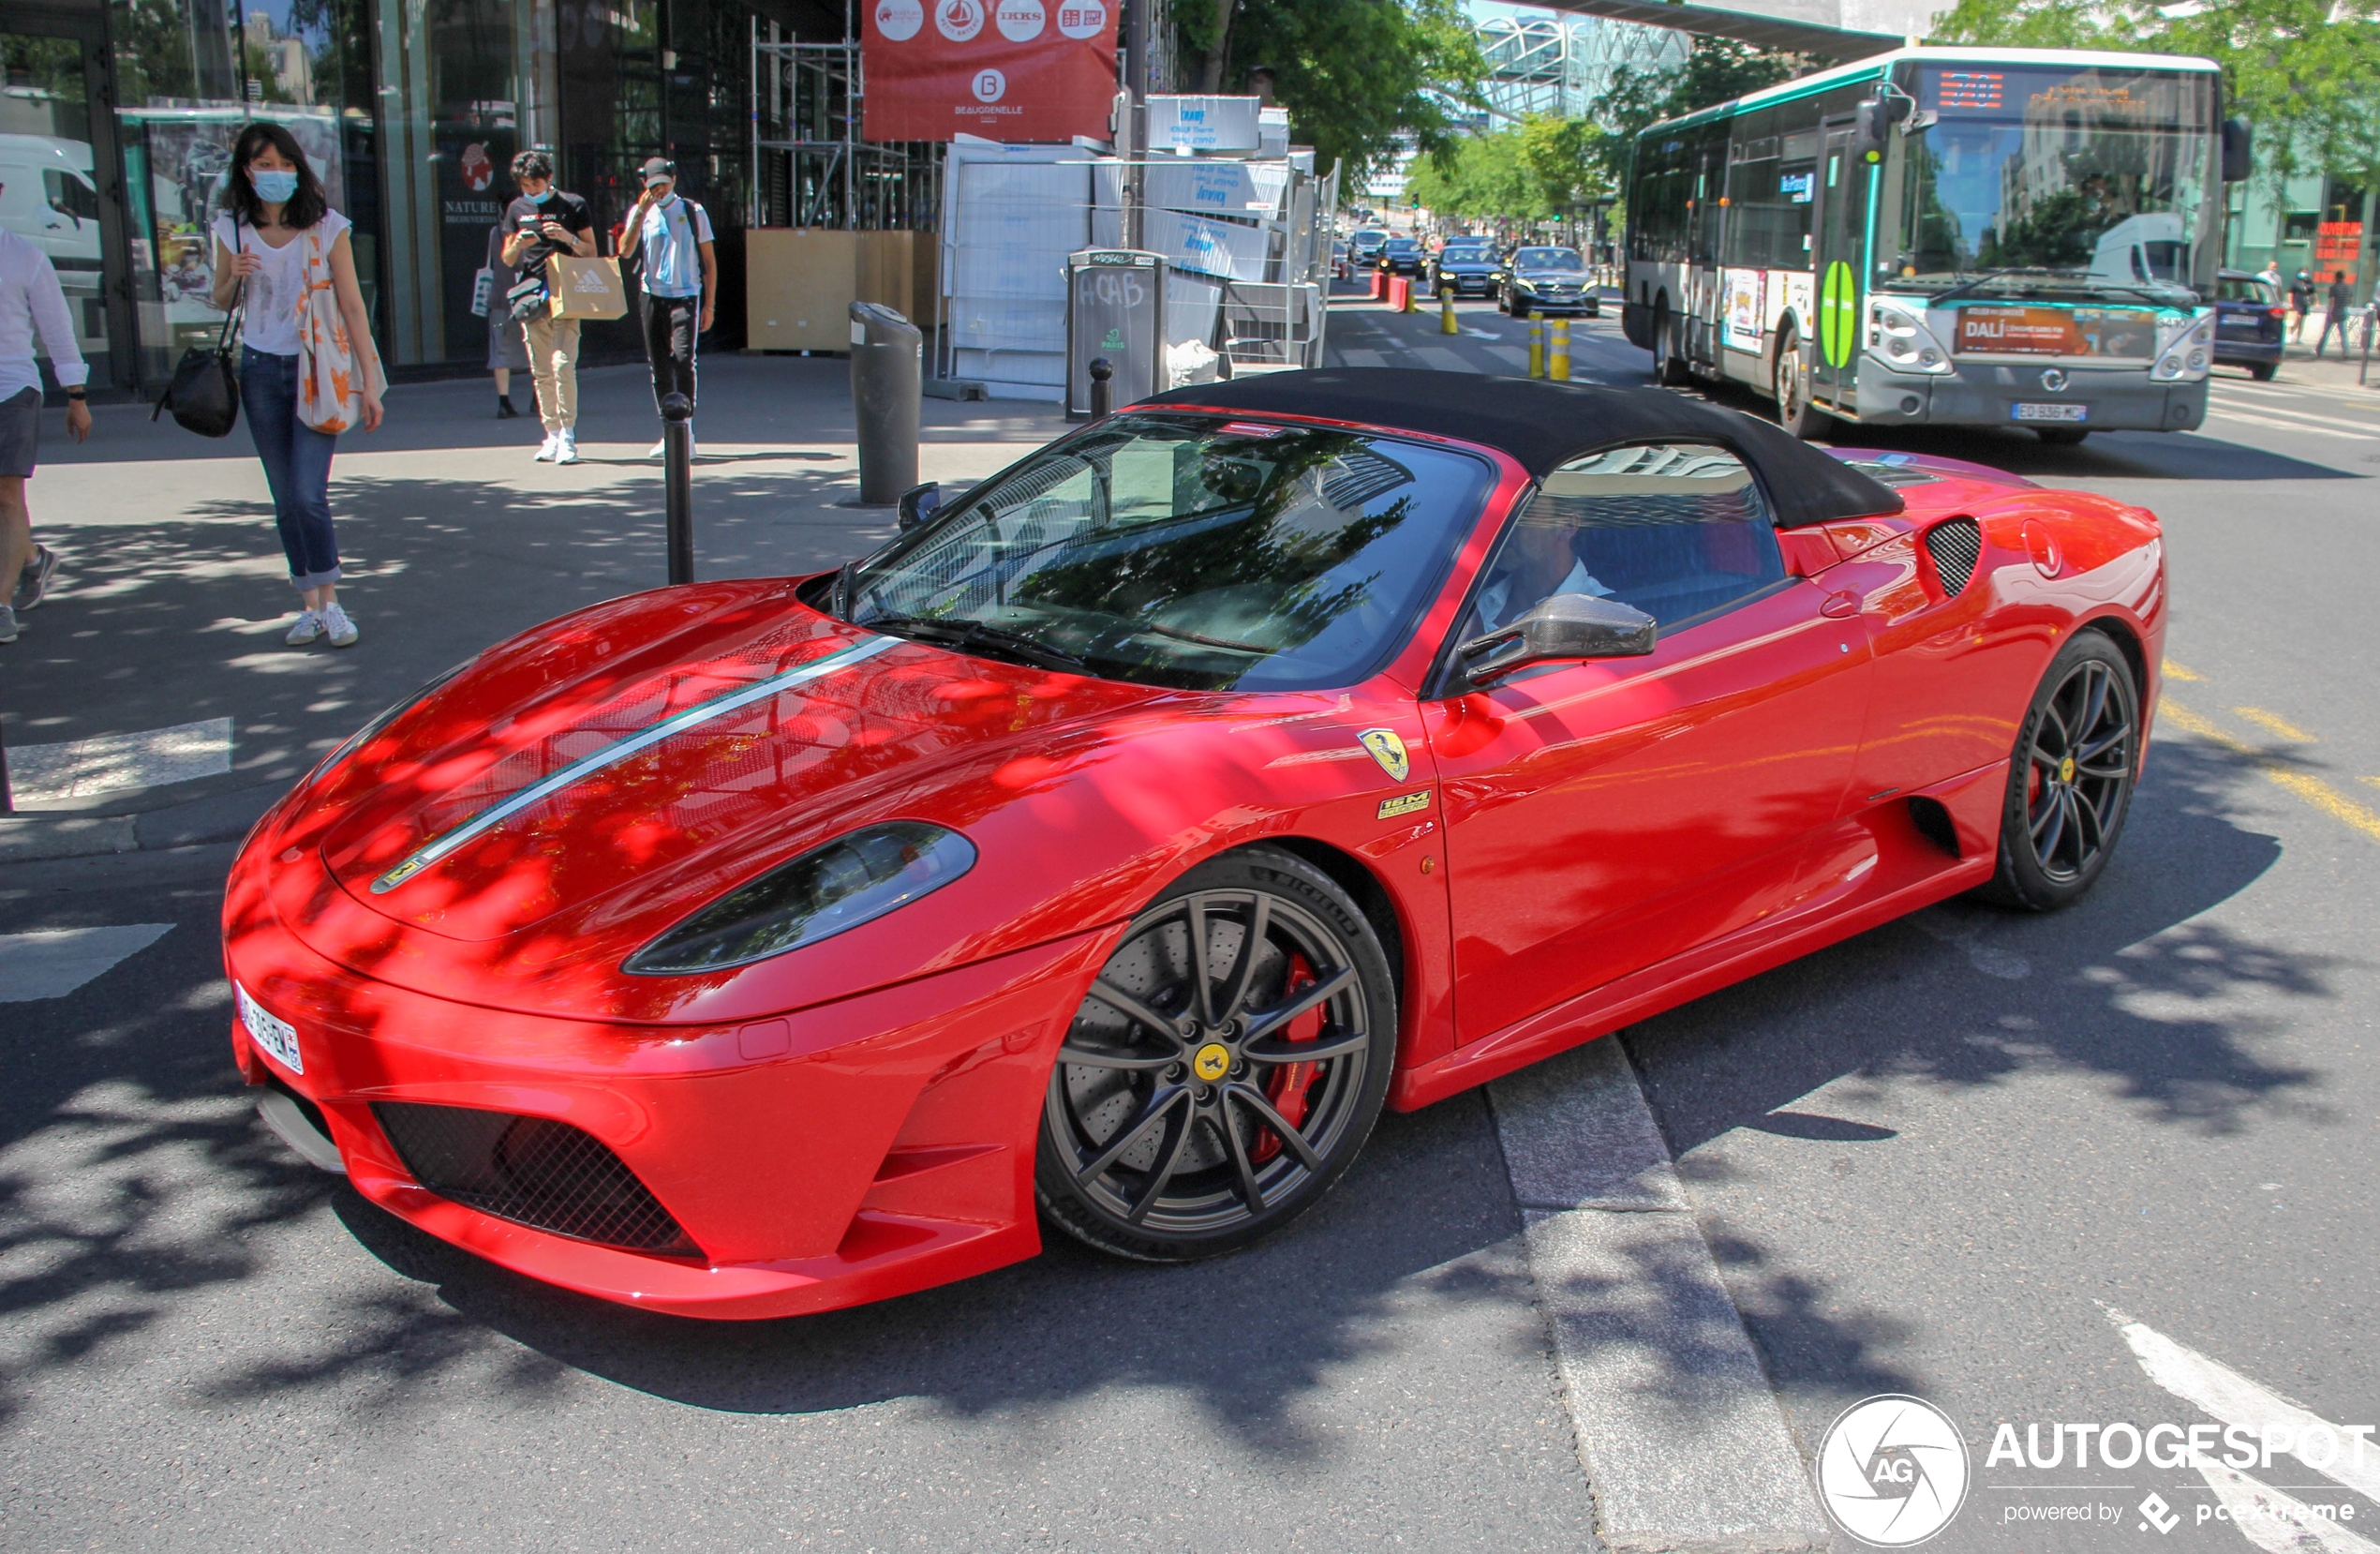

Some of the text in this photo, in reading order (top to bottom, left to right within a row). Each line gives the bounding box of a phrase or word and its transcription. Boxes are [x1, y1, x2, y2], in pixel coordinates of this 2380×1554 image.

[1000, 11, 1042, 21] IKKS
[940, 18, 955, 34] PETIT
[955, 106, 1023, 114] BEAUGRENELLE
[445, 201, 497, 213] NATURE
[573, 284, 609, 293] adidas
[1079, 272, 1143, 308] ACAB
[1965, 319, 2004, 338] DALÍ
[1382, 791, 1430, 809] 16M
[1380, 800, 1428, 818] SCUDERIA
[1275, 872, 1359, 936] MICHELIN
